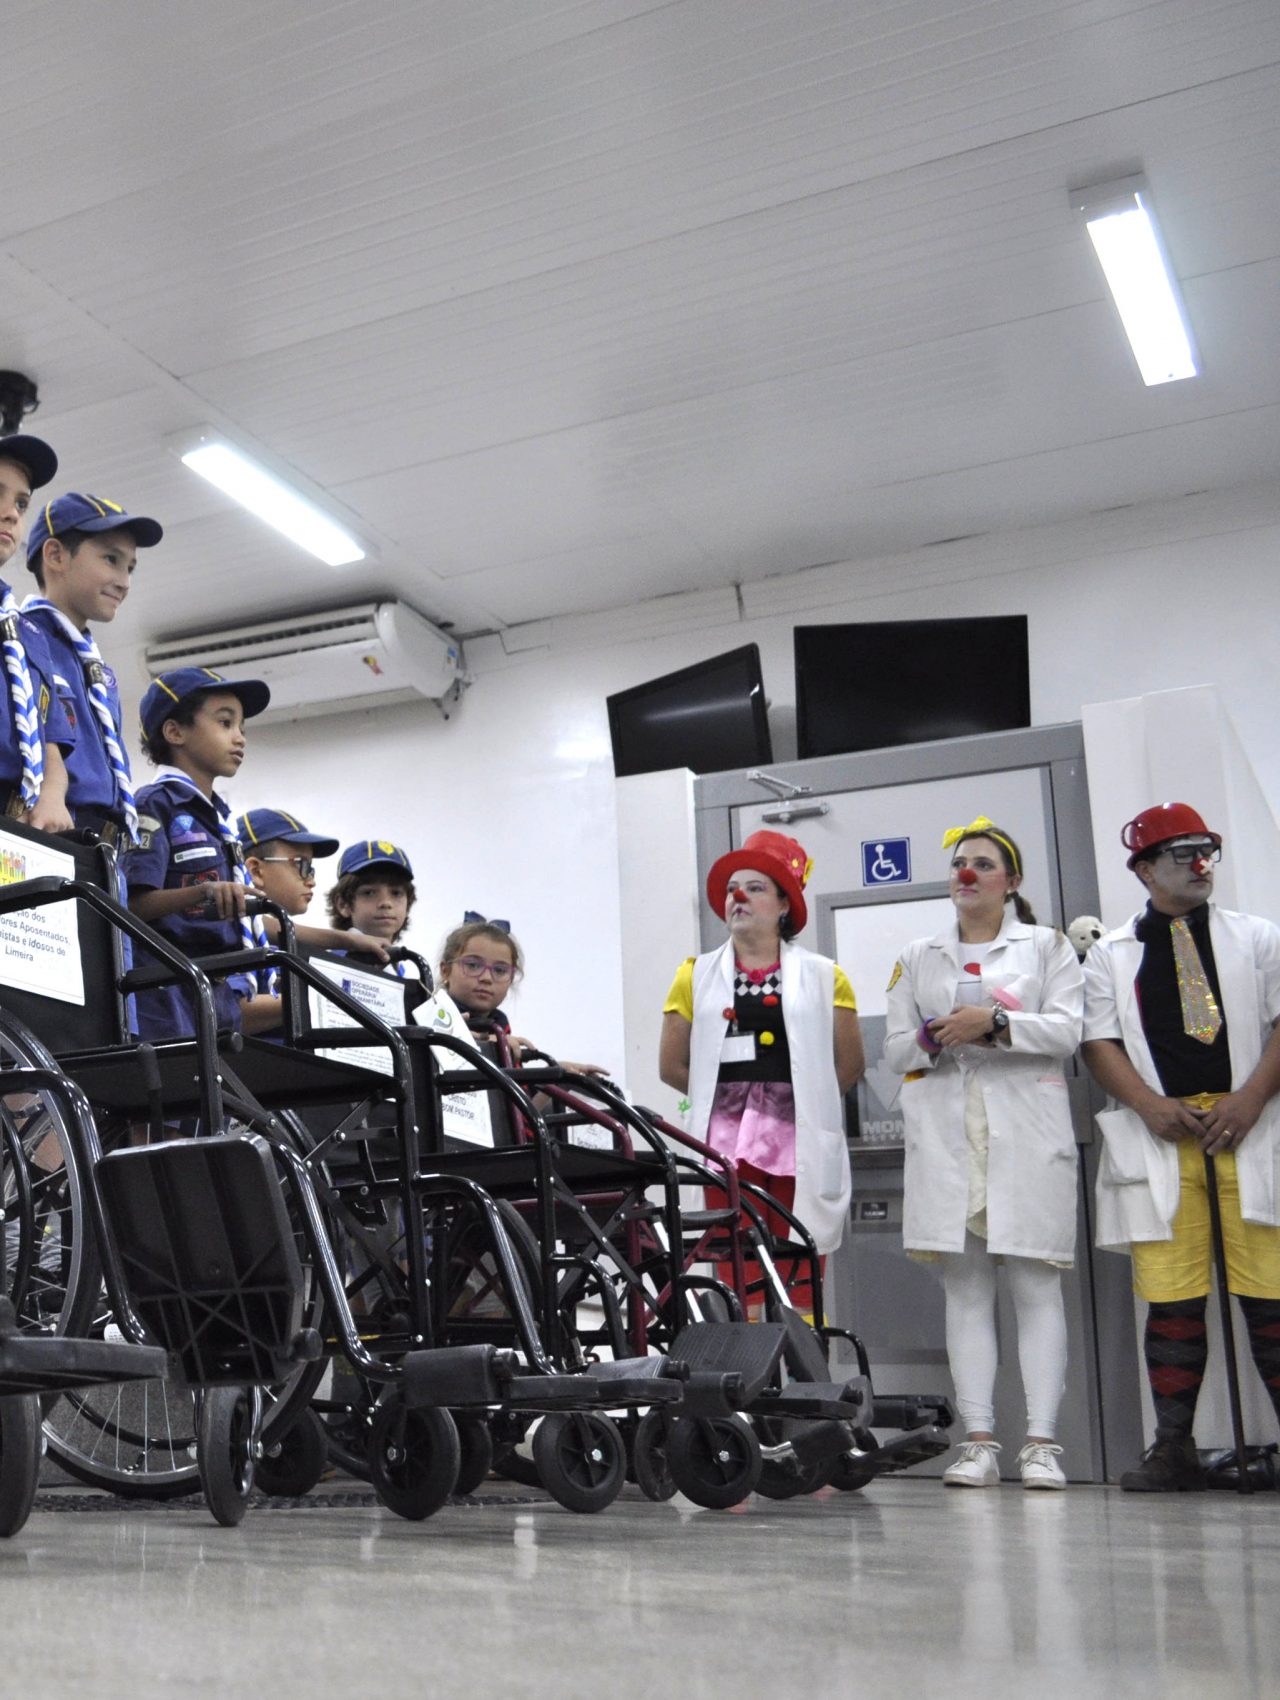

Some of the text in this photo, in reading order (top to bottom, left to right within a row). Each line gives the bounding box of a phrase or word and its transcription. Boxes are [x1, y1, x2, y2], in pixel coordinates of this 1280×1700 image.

[31, 912, 46, 923] dos
[22, 938, 28, 946] e
[5, 944, 34, 961] Limeira
[862, 1120, 905, 1135] MON
